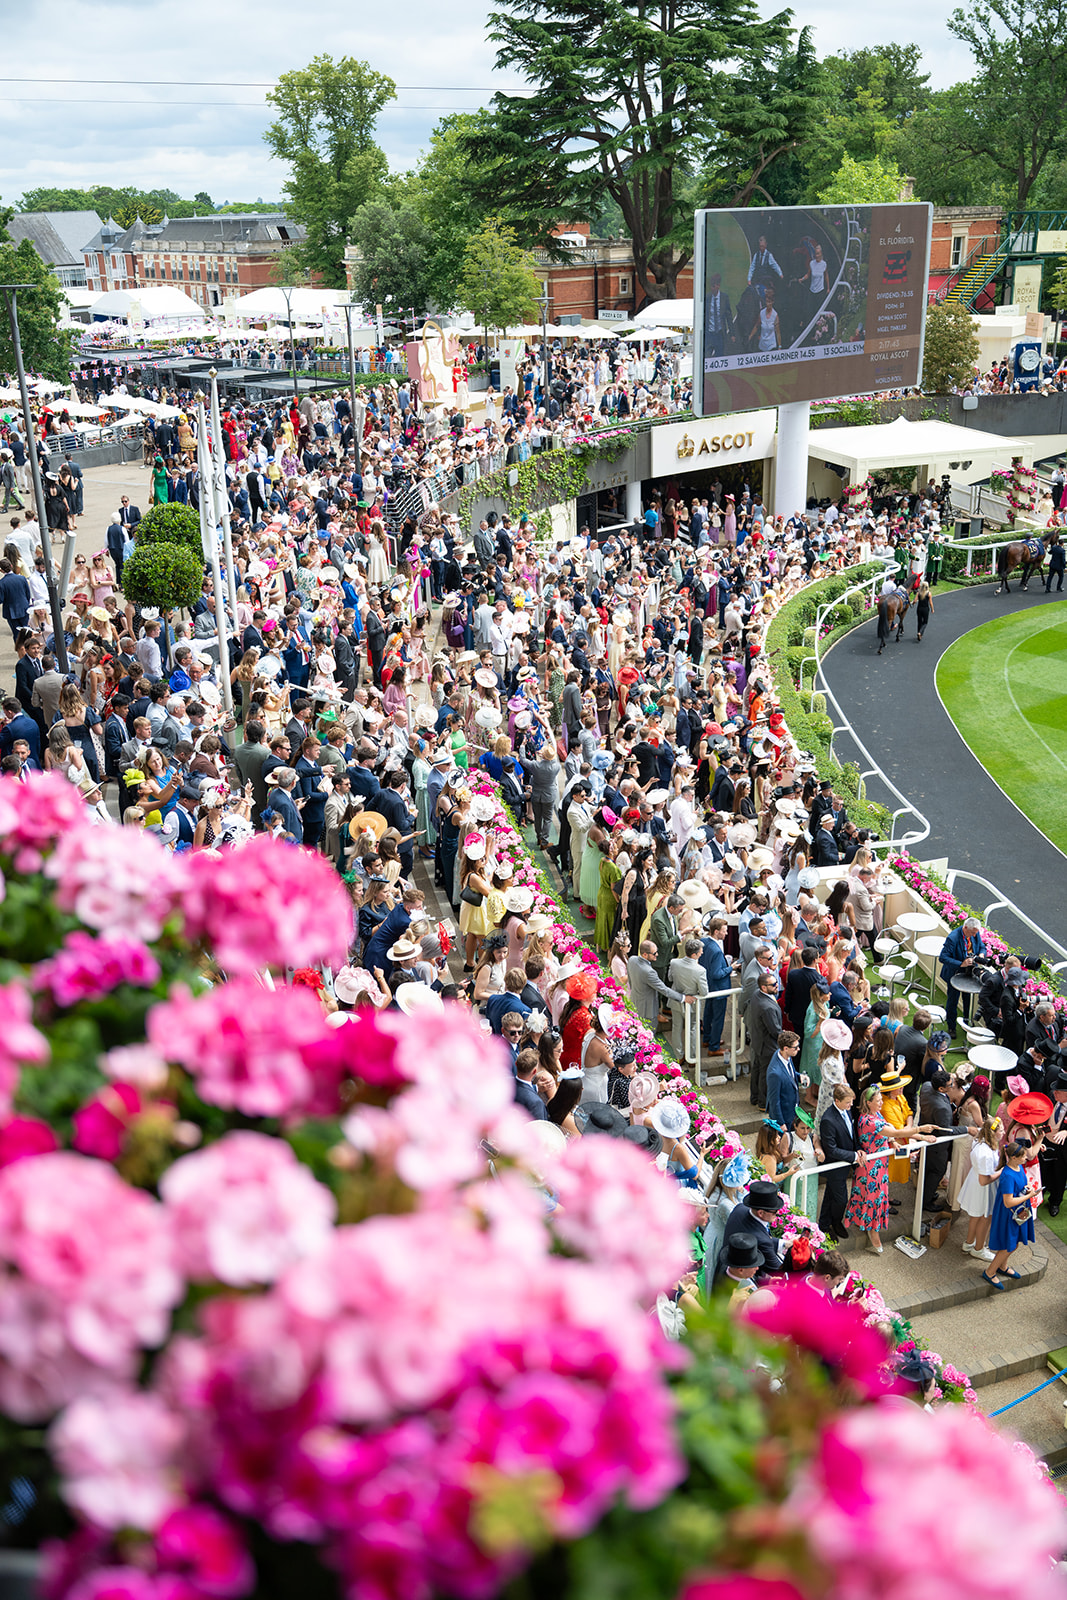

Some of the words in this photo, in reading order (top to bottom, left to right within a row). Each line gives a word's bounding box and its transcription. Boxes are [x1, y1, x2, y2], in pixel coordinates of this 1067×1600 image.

[895, 223, 901, 234] 4
[879, 237, 887, 246] EL
[887, 236, 915, 245] FLORIDITA
[1016, 287, 1036, 296] ROYAL
[1016, 295, 1036, 304] ASCOT
[709, 359, 729, 369] 40.75
[737, 357, 744, 366] 12
[745, 354, 770, 366] SAVAGE
[771, 351, 799, 363] MARINER
[800, 349, 816, 359] 14.55
[823, 347, 830, 356] 13
[830, 345, 851, 356] SOCIAL
[870, 353, 889, 363] ROYAL
[890, 350, 910, 360] ASCOT
[697, 430, 756, 456] ASCOT
